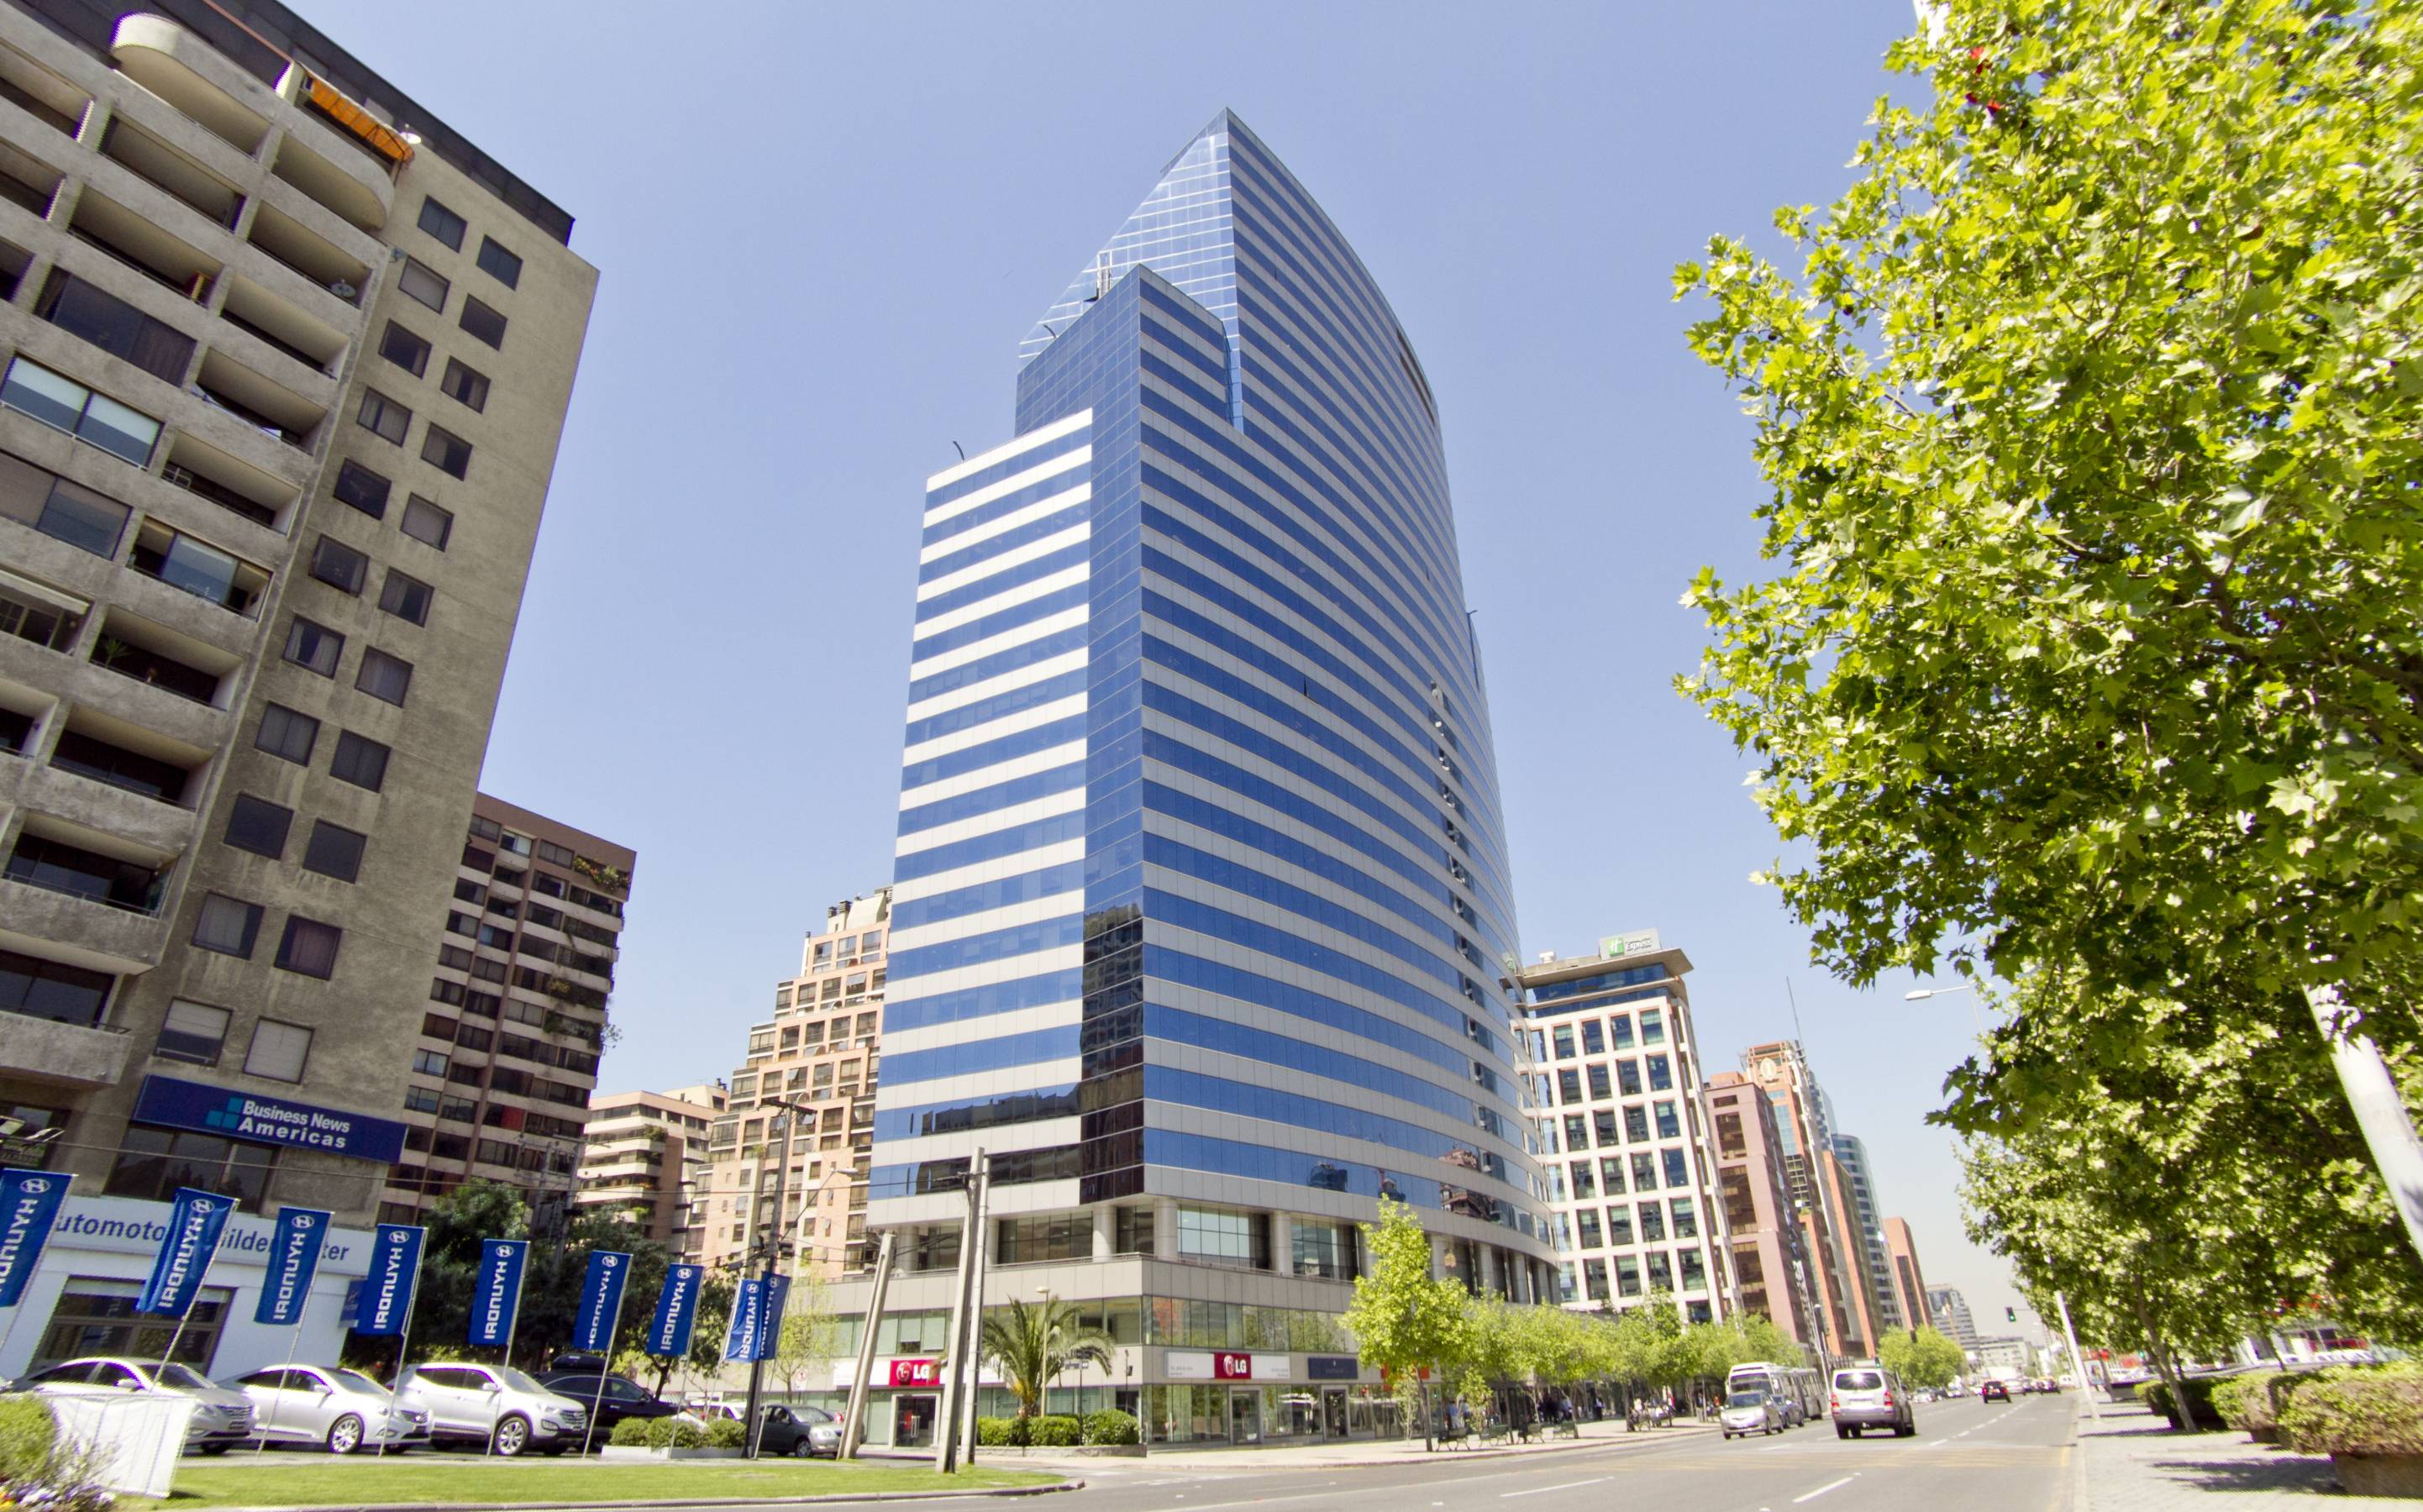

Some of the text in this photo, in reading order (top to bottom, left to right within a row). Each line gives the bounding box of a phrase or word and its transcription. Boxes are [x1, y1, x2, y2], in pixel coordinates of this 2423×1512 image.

[242, 1100, 350, 1133] Business News
[238, 1117, 347, 1148] Americas
[55, 1213, 167, 1242] utomoto
[738, 1295, 757, 1359] HYUNDAI
[912, 1363, 932, 1380] LG
[1234, 1358, 1248, 1374] LG
